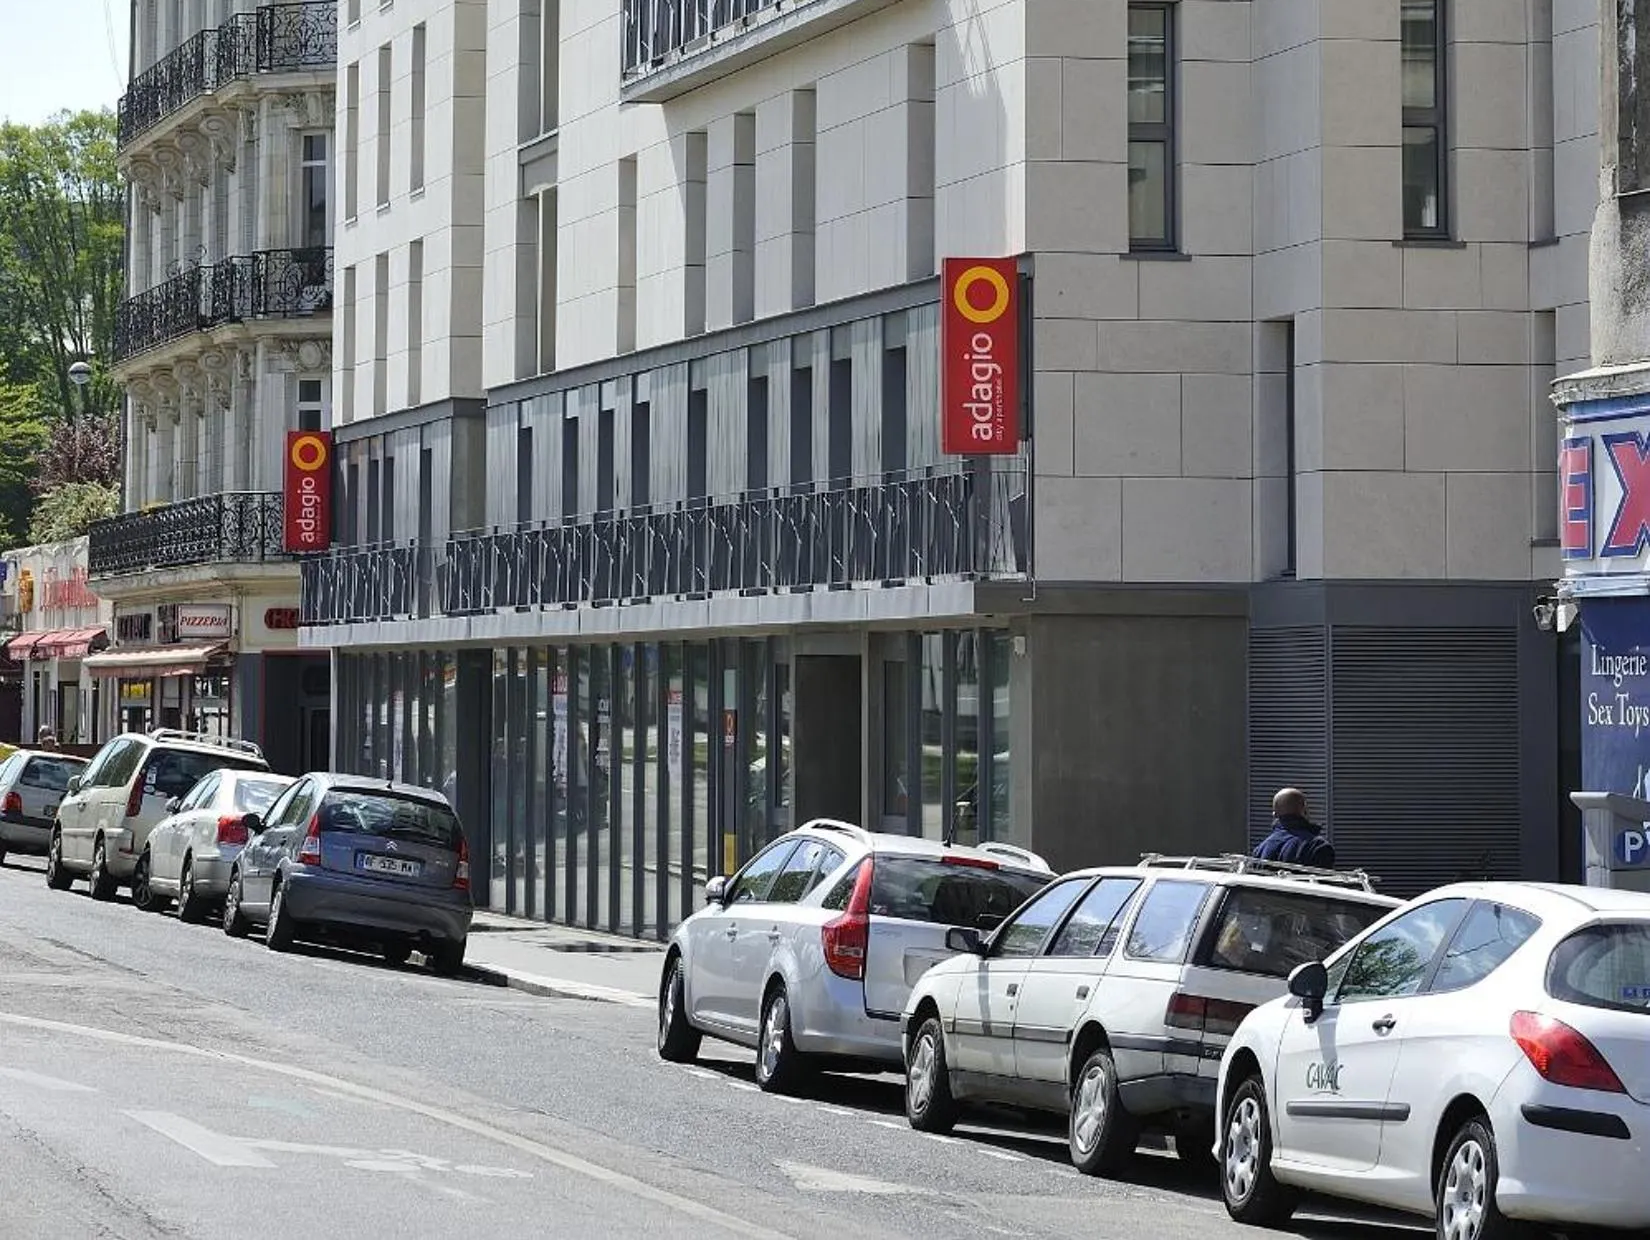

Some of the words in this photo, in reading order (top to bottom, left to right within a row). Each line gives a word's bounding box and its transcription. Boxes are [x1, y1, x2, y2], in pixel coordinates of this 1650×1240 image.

[963, 332, 1002, 441] adagio
[296, 476, 320, 543] adagio
[180, 616, 228, 627] PIZZERIA
[1591, 645, 1648, 688] Lingerie
[1588, 692, 1614, 725] Sex
[1615, 692, 1650, 738] Toys
[1624, 831, 1644, 863] P
